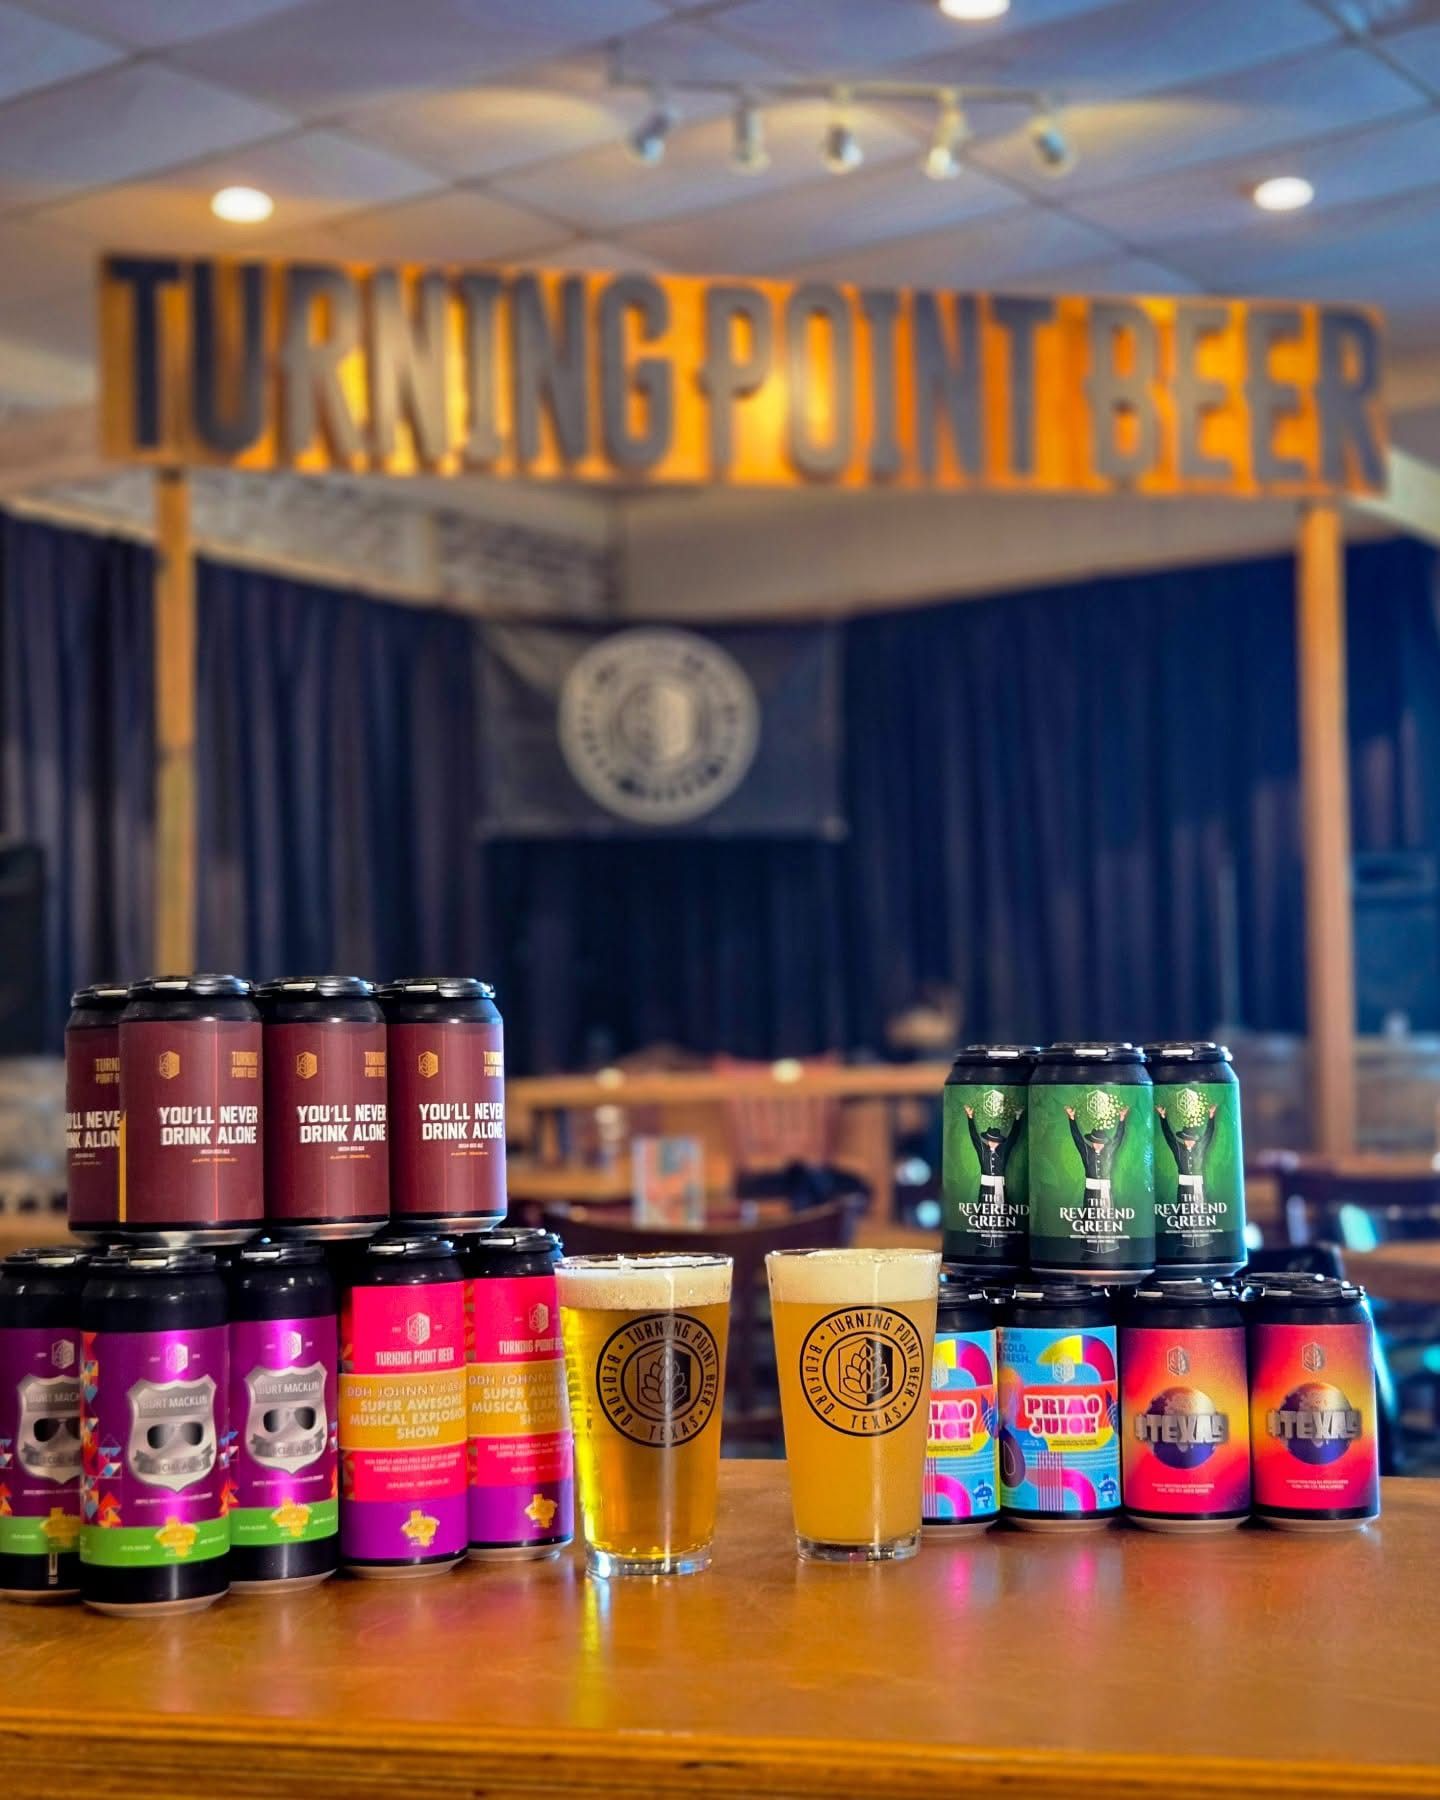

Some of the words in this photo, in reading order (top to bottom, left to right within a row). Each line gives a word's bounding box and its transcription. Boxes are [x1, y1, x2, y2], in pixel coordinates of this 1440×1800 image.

[106, 256, 672, 472] TURNING
[695, 283, 1058, 482] POINT
[1084, 299, 1388, 493] BEER
[86, 1110, 120, 1128] NEVE
[159, 1106, 215, 1125] YOU'LL
[220, 1105, 258, 1124] NEVER
[297, 1104, 351, 1123] YOU'LL
[355, 1104, 386, 1121] NEVER
[418, 1103, 471, 1121] YOU'LL
[475, 1103, 504, 1120] NEVER
[85, 1130, 120, 1148] ALON
[161, 1127, 212, 1146] DRINK
[217, 1126, 257, 1145] ALONE
[300, 1125, 348, 1143] DRINK
[353, 1123, 386, 1141] ALONE
[422, 1123, 468, 1141] DRINK
[473, 1122, 503, 1139] ALONE
[959, 1203, 1030, 1216] REVEREND
[1060, 1207, 1135, 1221] REVEREND
[1154, 1202, 1227, 1217] REVEREND
[968, 1215, 1016, 1228] GREEN
[1072, 1220, 1123, 1234] GREEN
[1167, 1215, 1216, 1229] GREEN
[625, 1320, 691, 1345] TURNNG
[826, 1312, 893, 1336] TURNING
[692, 1330, 715, 1367] POINT
[894, 1323, 920, 1360] POINT
[375, 1351, 412, 1366] TURNING
[414, 1349, 436, 1364] POINT
[379, 1384, 434, 1397] JOHNNY
[700, 1374, 715, 1407] BEER
[904, 1366, 920, 1398] BEER
[483, 1386, 524, 1400] SUPER
[360, 1399, 402, 1412] SUPER
[471, 1401, 529, 1413] MUSICAL
[931, 1401, 976, 1421] IMO
[1025, 1396, 1101, 1415] PRIMO
[350, 1412, 407, 1426] MUSICAL
[649, 1415, 698, 1440] TEXAS
[851, 1406, 902, 1430] TEXAS
[1030, 1415, 1098, 1435] JUICE
[396, 1426, 439, 1440] SHOW
[928, 1421, 972, 1440] ICE
